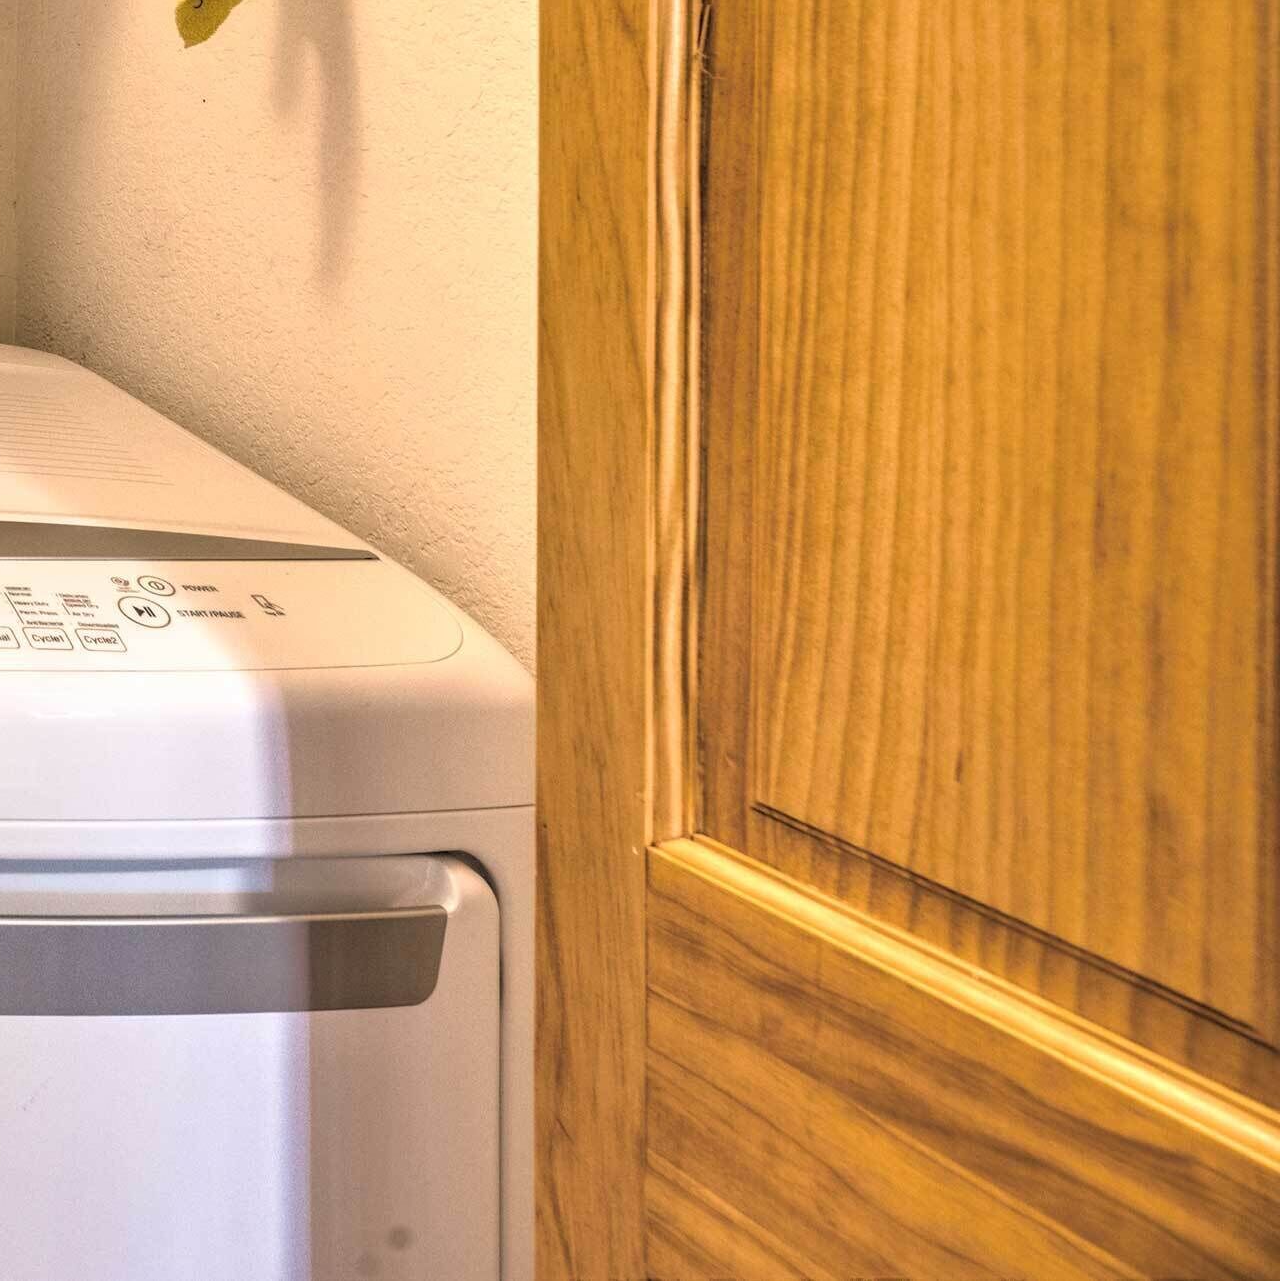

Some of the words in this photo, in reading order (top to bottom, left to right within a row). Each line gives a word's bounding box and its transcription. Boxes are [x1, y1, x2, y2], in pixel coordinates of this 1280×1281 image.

[181, 584, 220, 593] POWER
[31, 633, 64, 644] Cycle1
[83, 635, 119, 645] Cycle2
